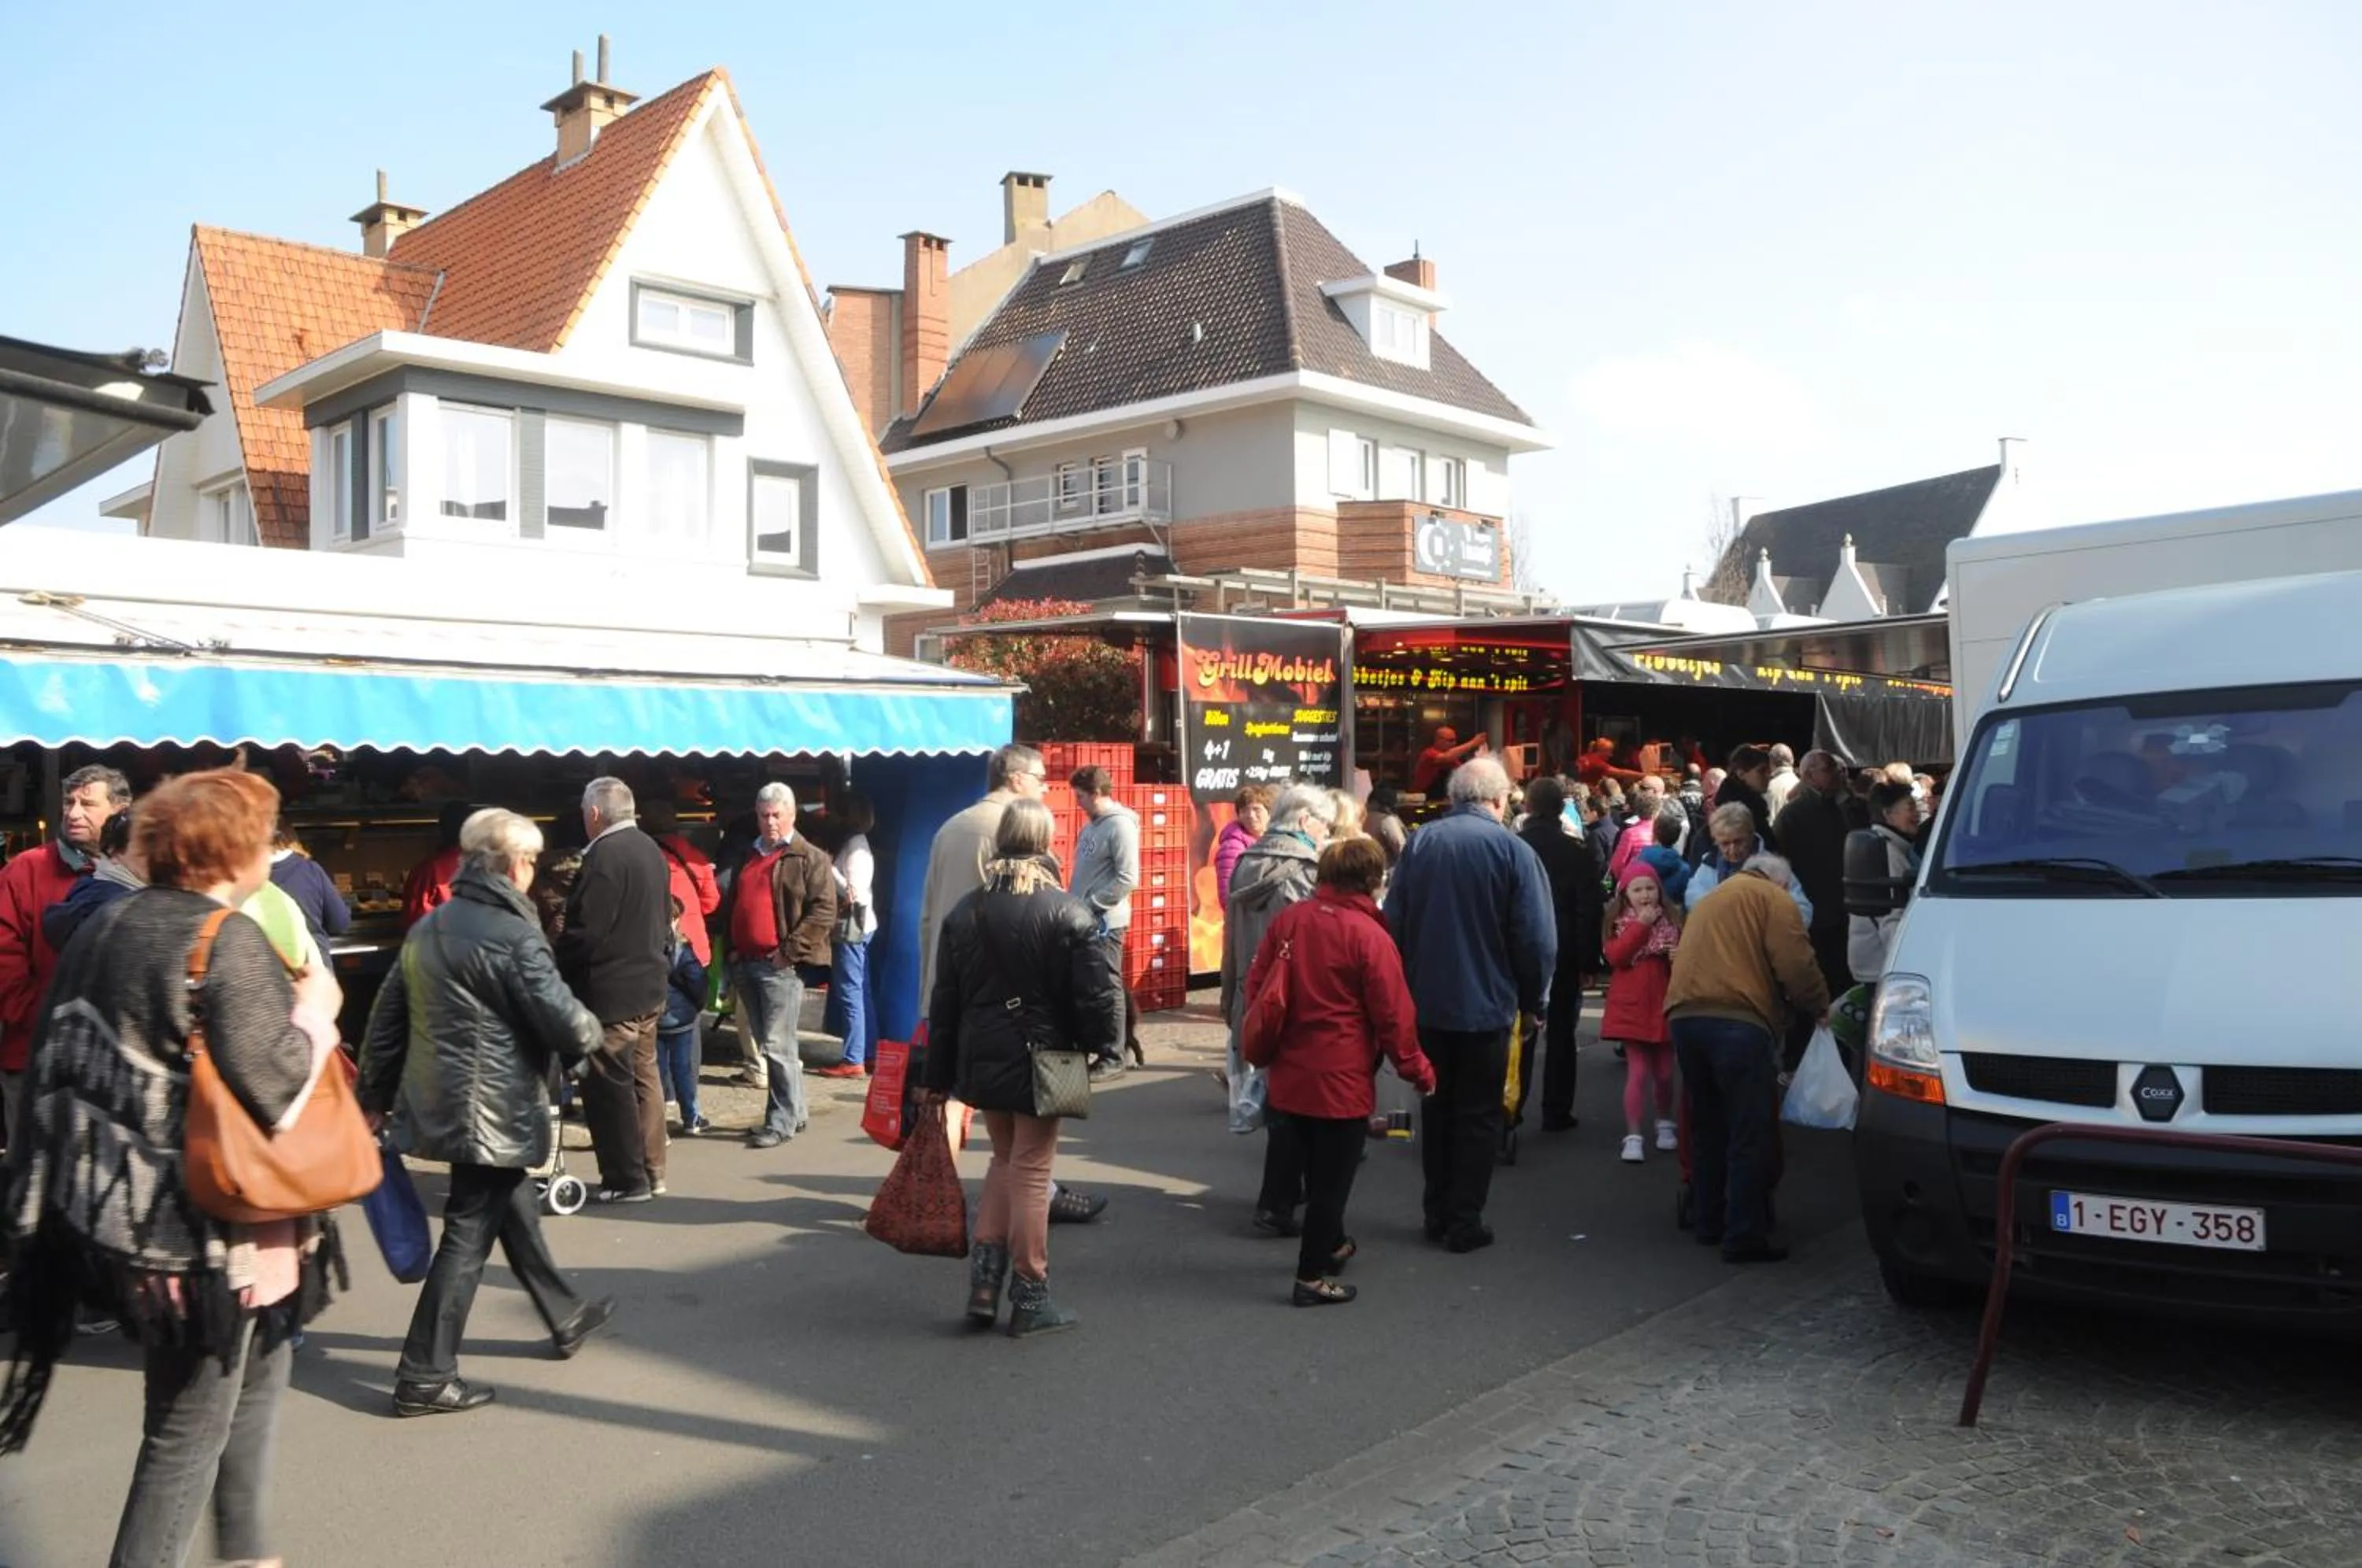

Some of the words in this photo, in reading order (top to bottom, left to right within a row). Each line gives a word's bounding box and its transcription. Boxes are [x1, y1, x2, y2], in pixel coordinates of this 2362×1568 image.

[1353, 666, 1405, 688] bbetjes
[1204, 739, 1231, 760] 4+1
[1195, 767, 1240, 790] GRATIS
[2073, 1200, 2256, 1244] 1-EGY-358
